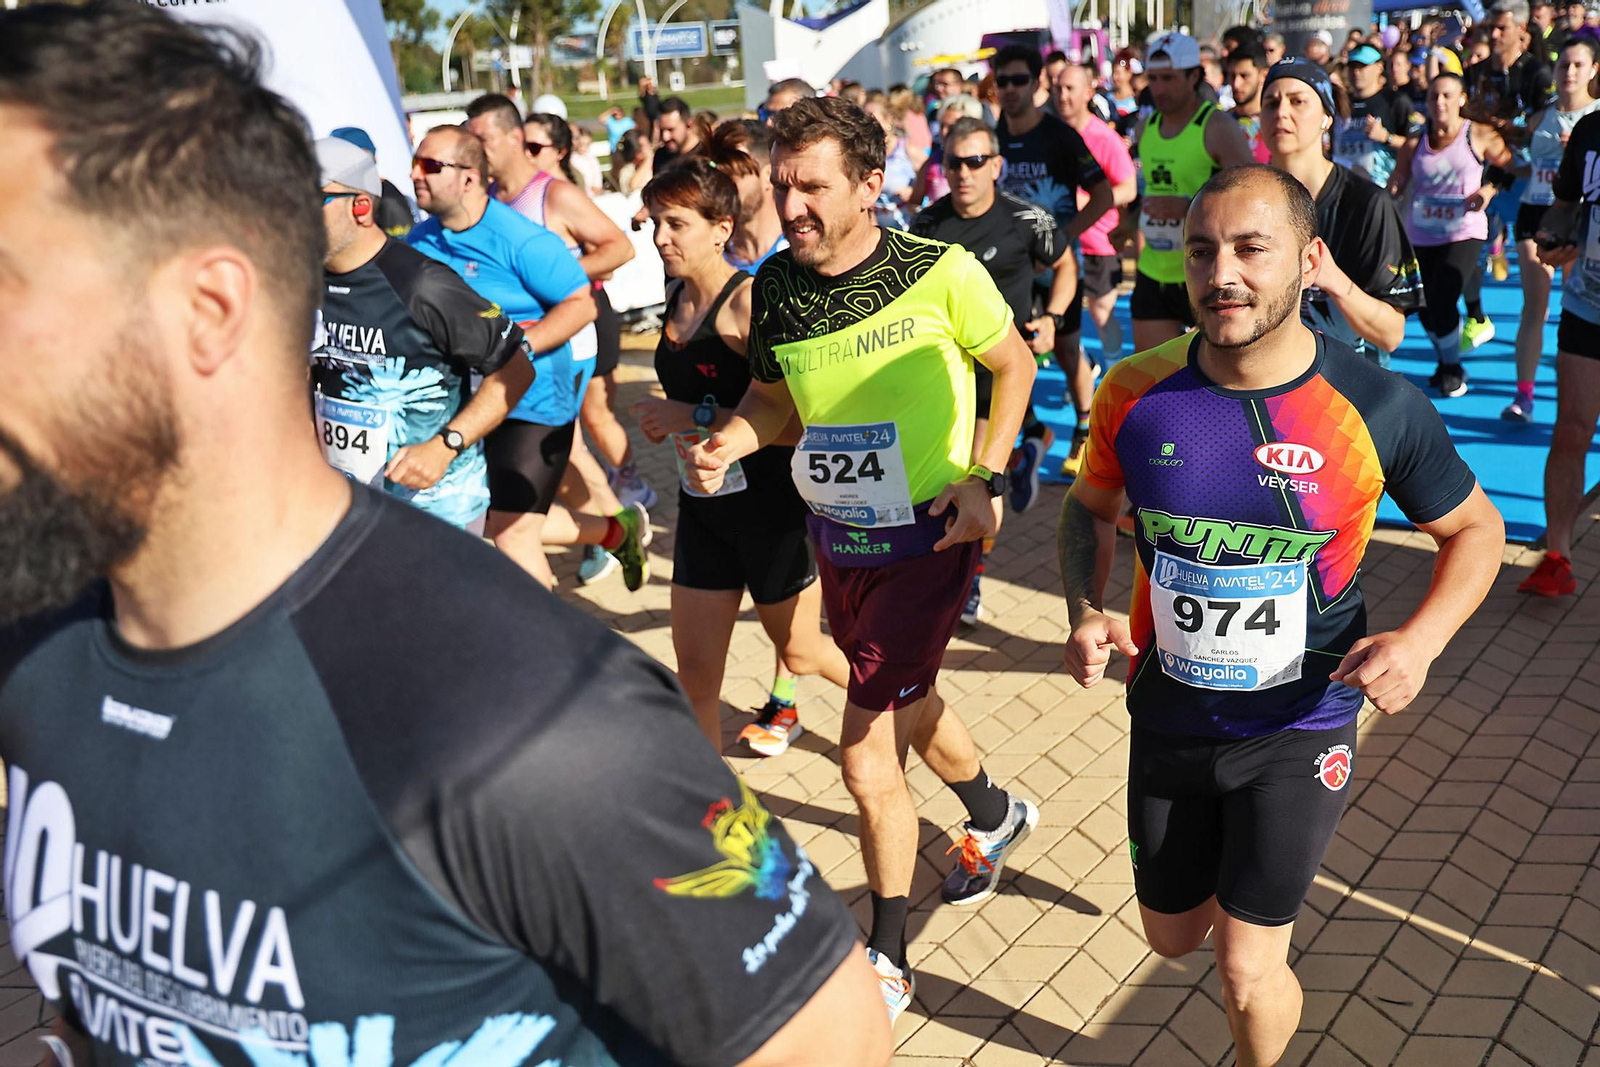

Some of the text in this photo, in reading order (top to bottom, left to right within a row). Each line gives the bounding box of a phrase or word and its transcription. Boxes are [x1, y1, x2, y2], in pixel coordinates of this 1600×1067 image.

[1423, 205, 1455, 220] 345
[324, 322, 387, 355] HUELVA
[323, 420, 370, 454] 894
[831, 433, 867, 443] AVATEL
[808, 451, 885, 484] 524
[1265, 447, 1315, 470] KIA
[1257, 474, 1319, 494] VEYSER
[832, 543, 892, 555] HANKER
[1177, 569, 1209, 586] HUELVA
[1213, 575, 1265, 588] AVATEL
[1265, 569, 1298, 589] '24
[1172, 595, 1281, 637] 974
[1176, 657, 1247, 681] Wayalia
[1193, 654, 1225, 663] SANCHEZ
[71, 842, 305, 1010] HUELVA
